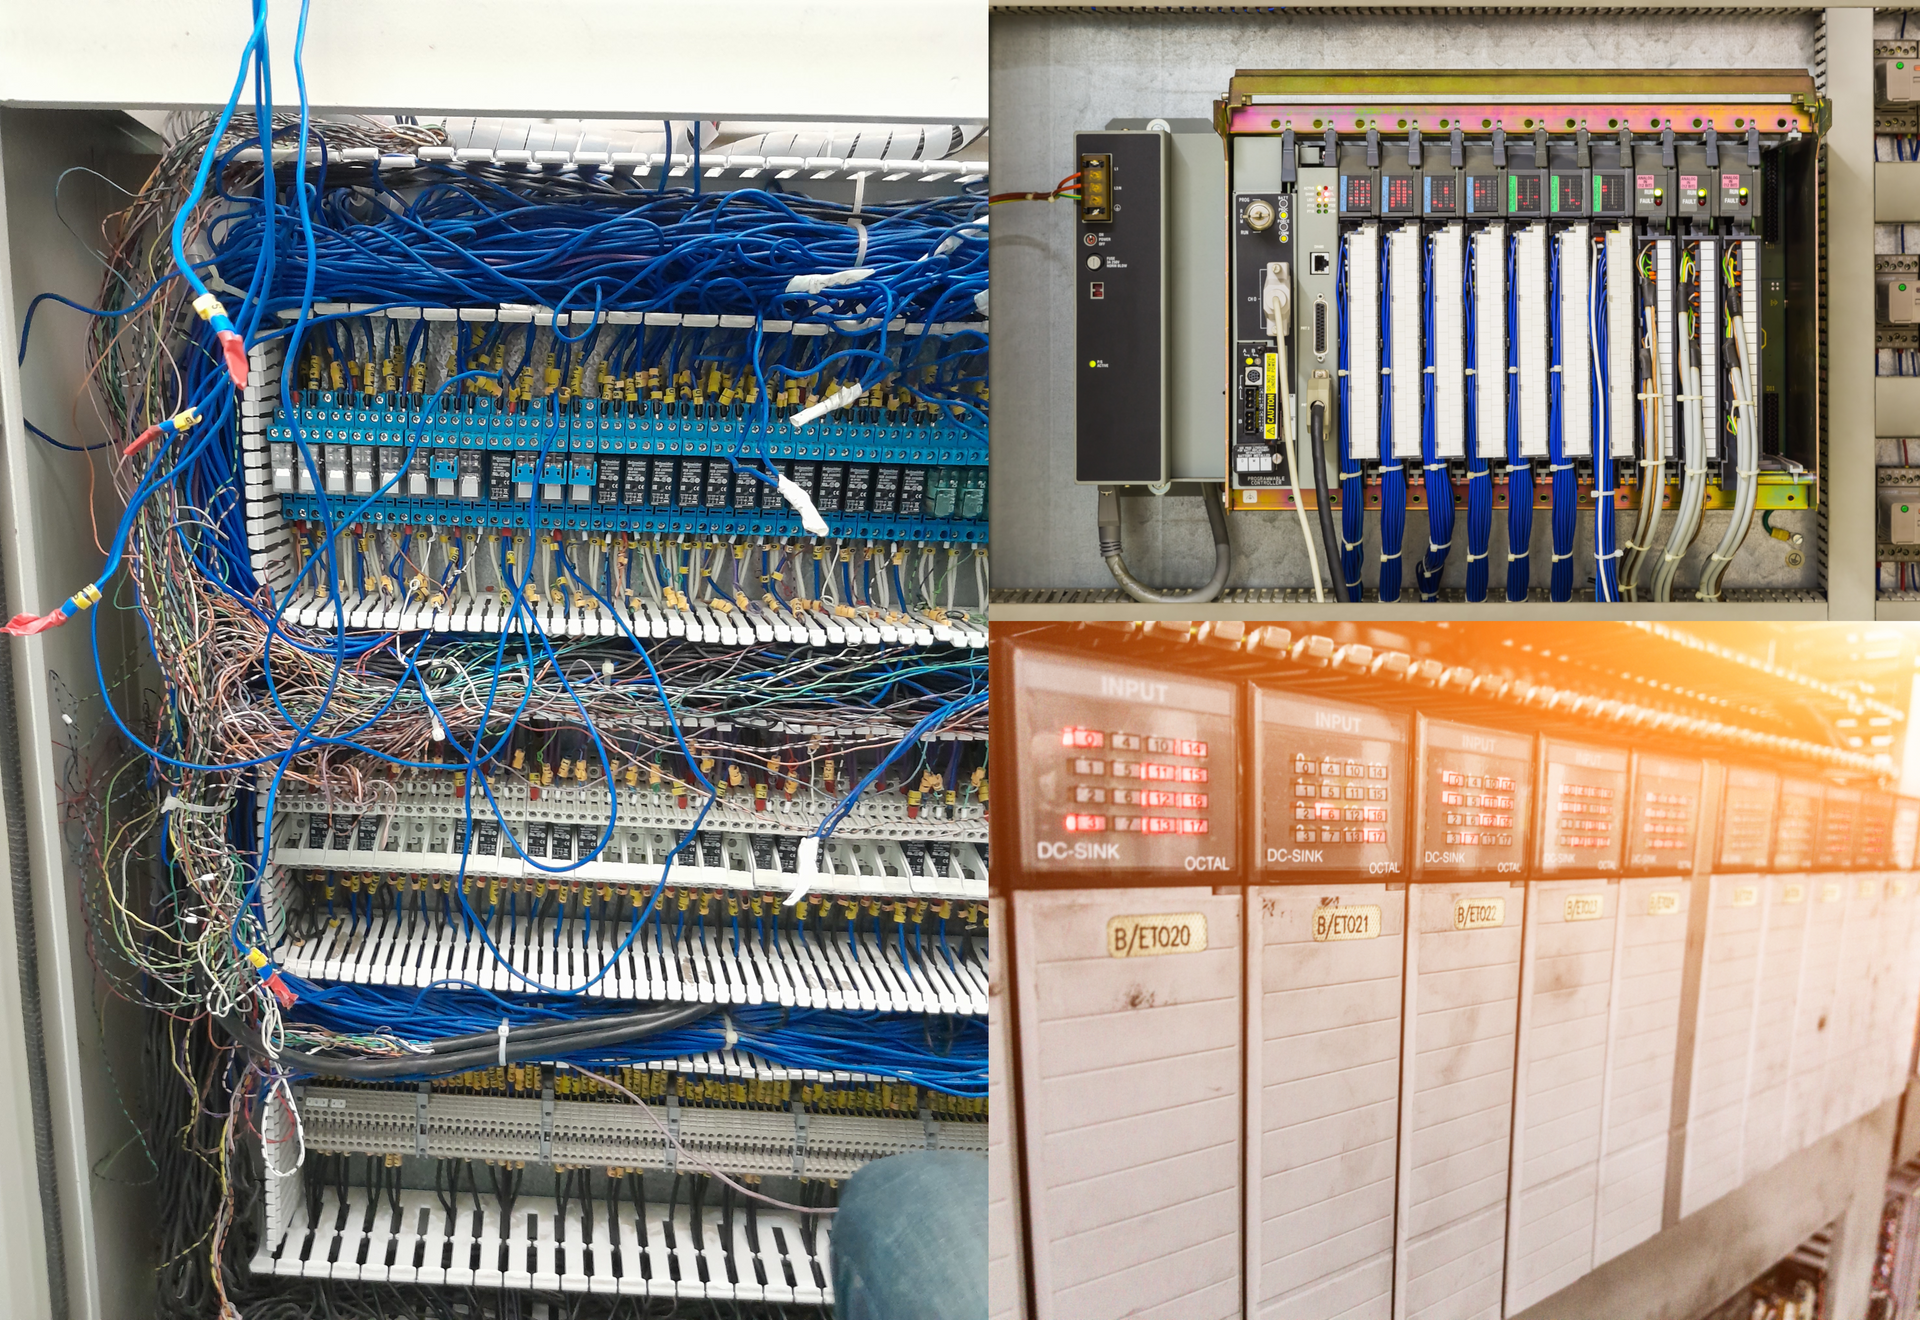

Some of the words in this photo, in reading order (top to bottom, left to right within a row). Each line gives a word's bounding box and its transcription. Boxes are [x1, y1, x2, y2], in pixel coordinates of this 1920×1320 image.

[1267, 394, 1275, 424] CAUTION
[1101, 676, 1168, 702] INPUT
[1316, 711, 1361, 732] INPUT
[1086, 734, 1094, 744] 0
[1122, 737, 1131, 747] 4
[1154, 741, 1168, 751] 10
[1188, 744, 1201, 754] 14
[1462, 734, 1496, 753] INPUT
[1125, 764, 1131, 775] 5
[1155, 766, 1166, 778] 11
[1189, 769, 1201, 780] 15
[1302, 763, 1309, 774] 0
[1328, 765, 1334, 774] 4
[1350, 767, 1360, 776] 10
[1373, 768, 1382, 777] 14
[1088, 789, 1096, 800] 2
[1125, 791, 1132, 801] 6
[1156, 793, 1170, 805] 12
[1190, 796, 1202, 806] 16
[1328, 788, 1334, 797] 5
[1350, 789, 1359, 798] 11
[1373, 790, 1382, 799] 15
[1303, 809, 1309, 818] 2
[1328, 810, 1334, 819] 6
[1350, 811, 1360, 820] 12
[1373, 811, 1382, 820] 16
[1088, 817, 1096, 828] 3
[1126, 818, 1134, 829] 7
[1156, 819, 1170, 830] 13
[1190, 820, 1203, 831] 17
[1303, 832, 1309, 841] 3
[1329, 833, 1334, 841] 7
[1350, 833, 1360, 841] 13
[1373, 833, 1382, 841] 17
[1037, 841, 1120, 860] DC-SINK
[1267, 848, 1323, 862] DC-SINK
[1425, 851, 1465, 863] DC-SINK
[1184, 856, 1230, 871] OCTAL
[1369, 862, 1400, 874] OCTAL
[1498, 862, 1521, 873] OCTAL
